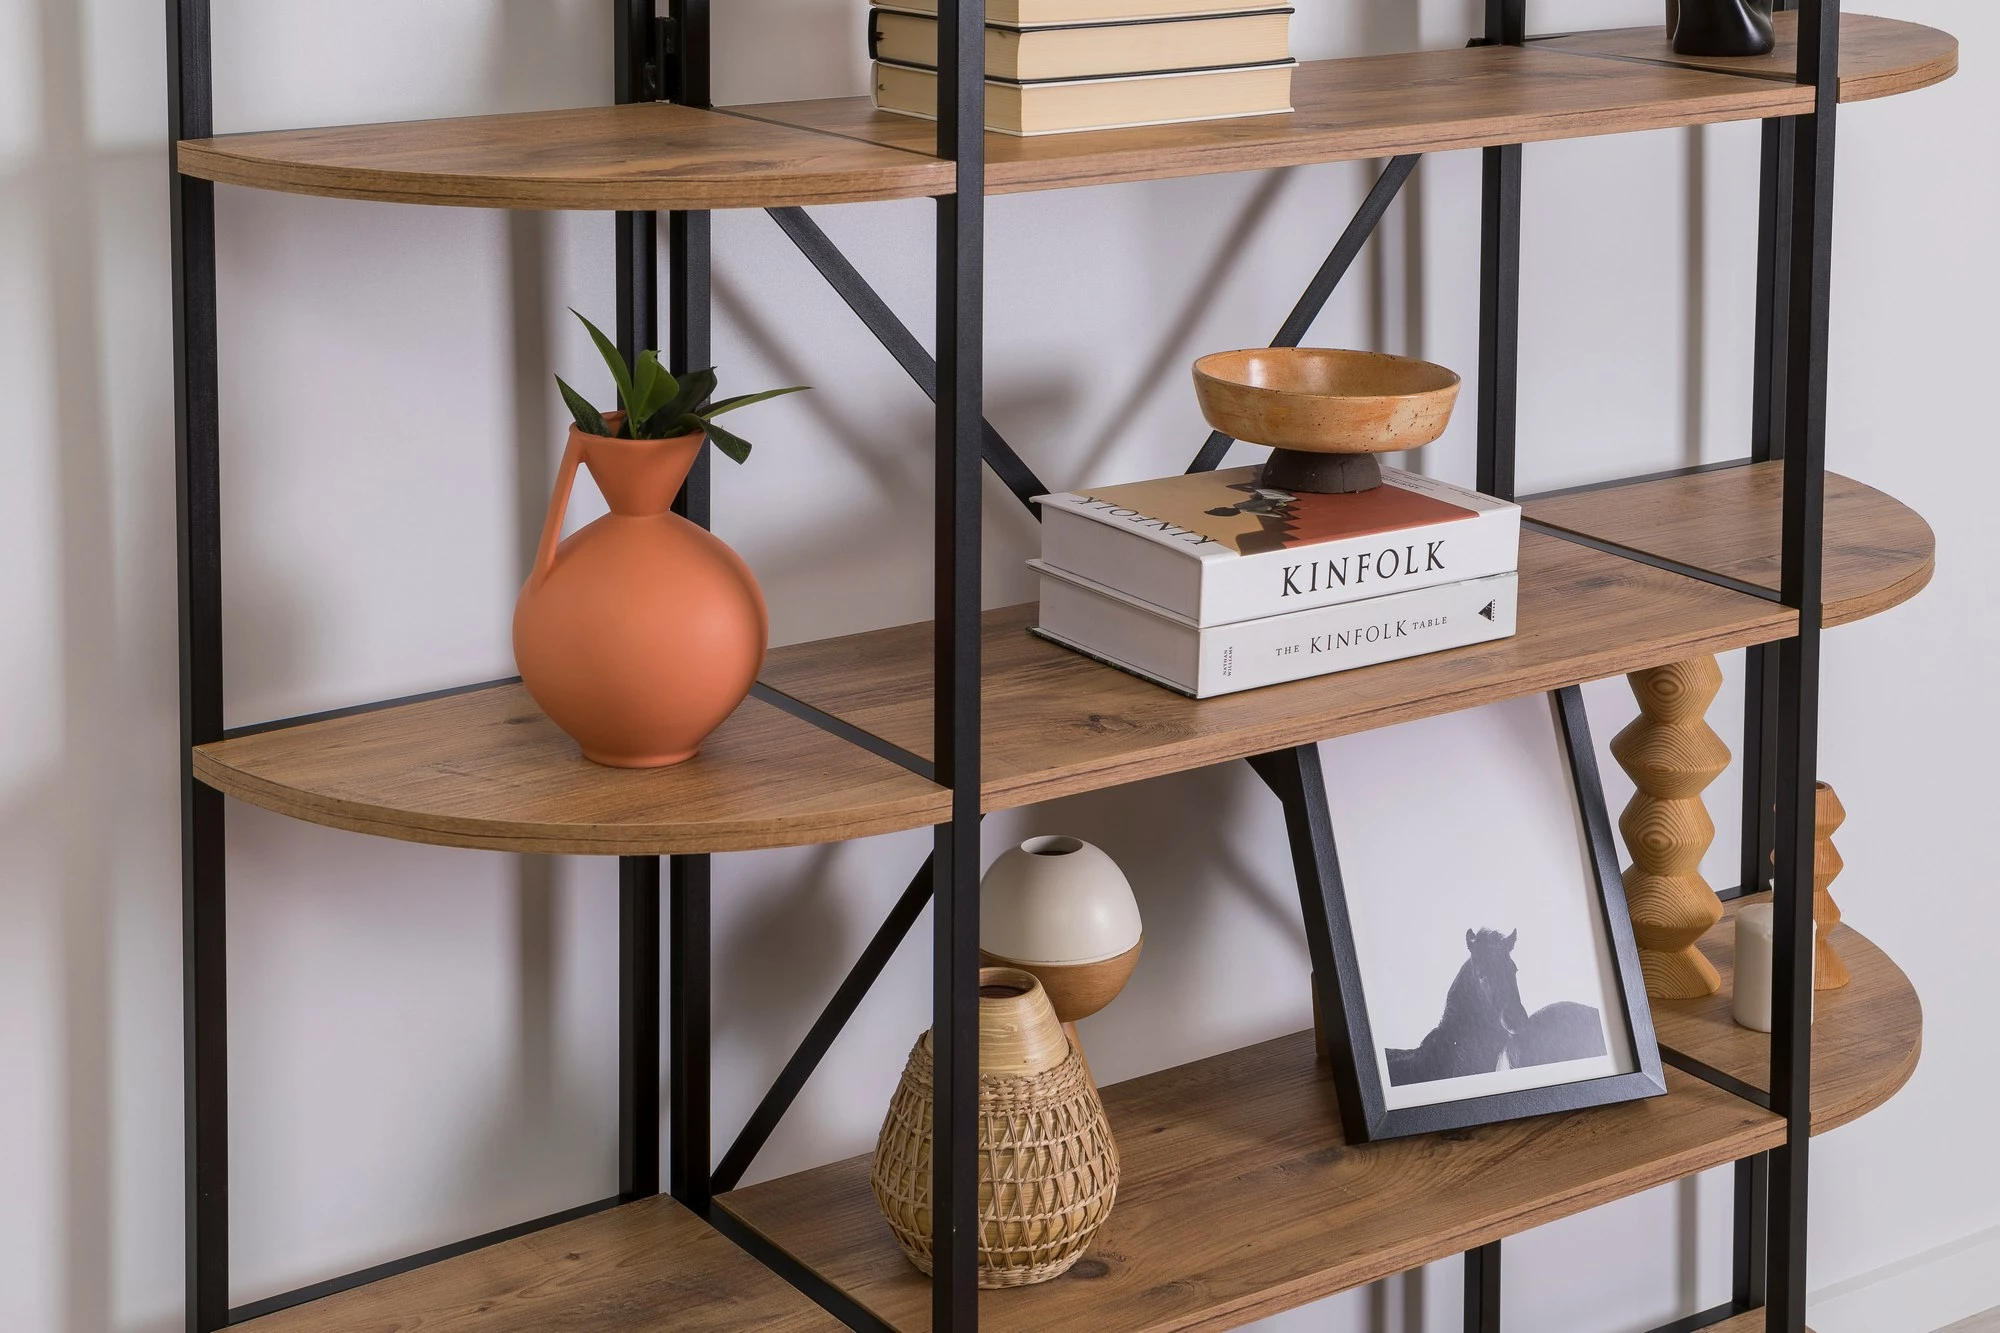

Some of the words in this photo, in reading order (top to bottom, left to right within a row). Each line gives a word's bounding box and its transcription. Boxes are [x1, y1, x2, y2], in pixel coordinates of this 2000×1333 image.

[1070, 496, 1219, 545] KINFOLK
[1281, 539, 1446, 597] KINFOLK
[1275, 644, 1300, 657] THE
[1310, 619, 1408, 655] KINFOLK
[1412, 616, 1448, 630] TABLE
